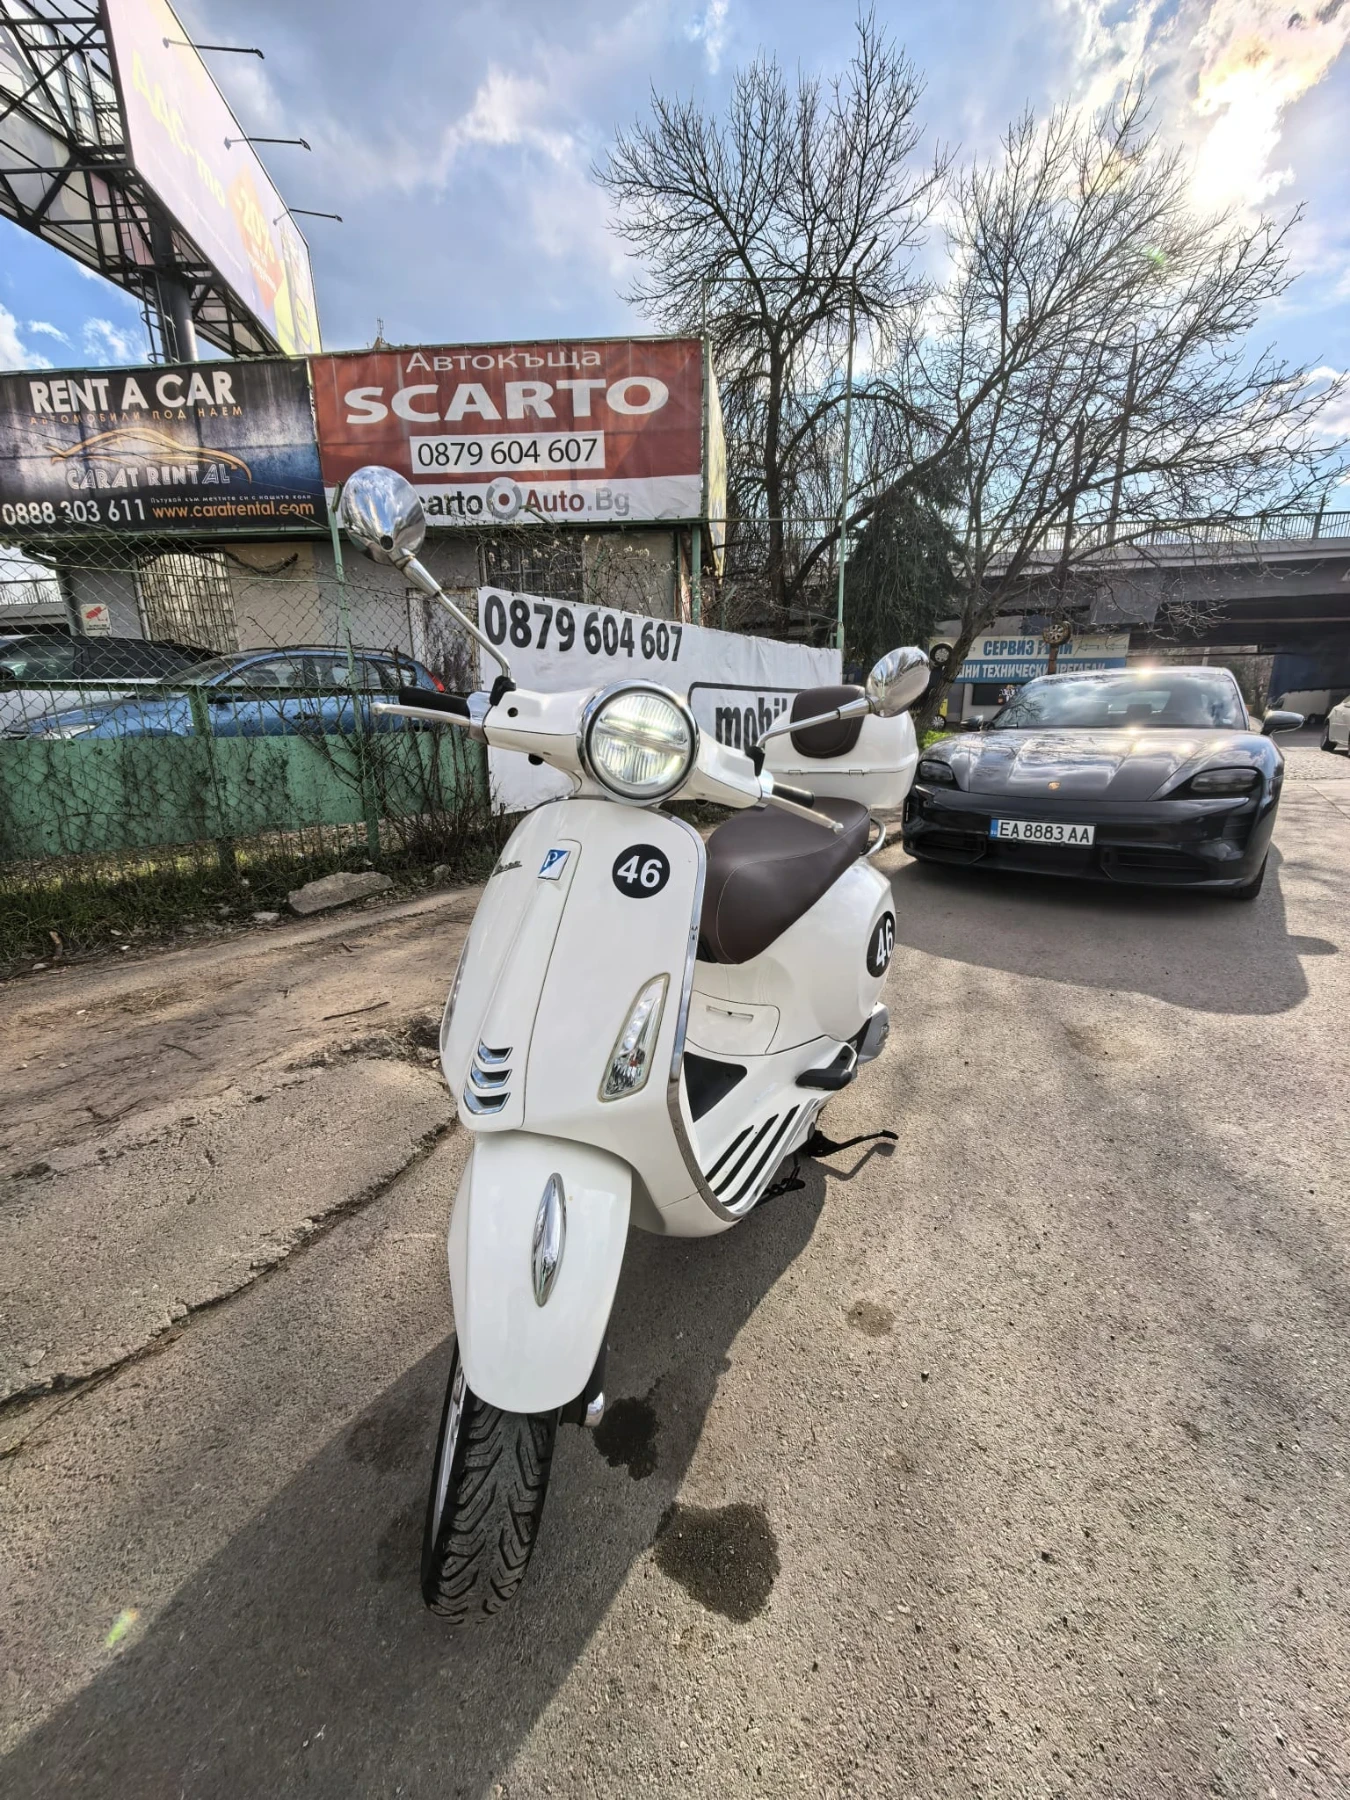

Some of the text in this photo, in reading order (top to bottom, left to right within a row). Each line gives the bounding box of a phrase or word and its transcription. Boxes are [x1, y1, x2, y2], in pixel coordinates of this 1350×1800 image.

[406, 350, 601, 373] Автокъща
[29, 371, 236, 413] RENT A CAR
[344, 376, 669, 424] SCARTO
[152, 409, 187, 421] ПОД
[198, 406, 243, 417] НАЕМ
[418, 438, 598, 467] 0879 604 607
[66, 467, 139, 490] CARAT
[2, 498, 146, 526] 0888 303 611
[152, 500, 315, 519] www.caratrental.com
[484, 600, 683, 662] 0879 604 607
[983, 640, 1035, 656] СЕРВИЗ
[1000, 822, 1090, 843] EA 8883 AA
[616, 855, 663, 888] 46
[876, 918, 893, 967] 46
